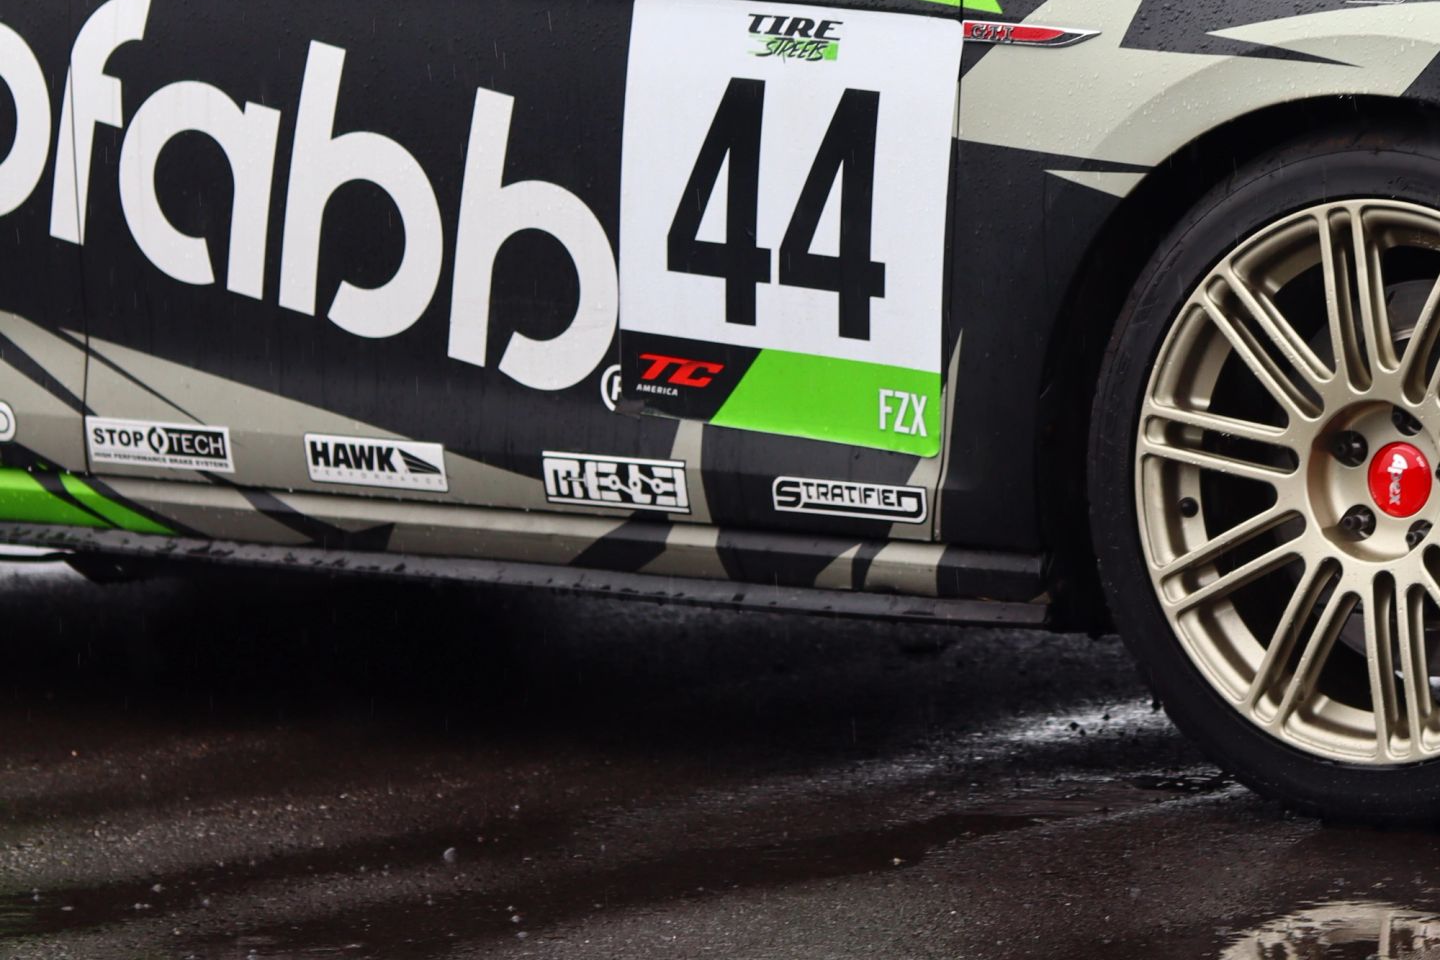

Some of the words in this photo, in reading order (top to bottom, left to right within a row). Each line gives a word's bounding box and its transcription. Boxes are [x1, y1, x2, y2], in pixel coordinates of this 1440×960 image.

[748, 13, 844, 41] TIRE
[971, 24, 1014, 43] GTI
[755, 37, 829, 63] STREETS
[667, 77, 885, 341] 44
[639, 354, 725, 388] TC
[636, 384, 678, 396] AMERICA
[879, 388, 928, 437] FZX
[310, 441, 397, 473] HAWK
[776, 480, 923, 518] STRATIFIED
